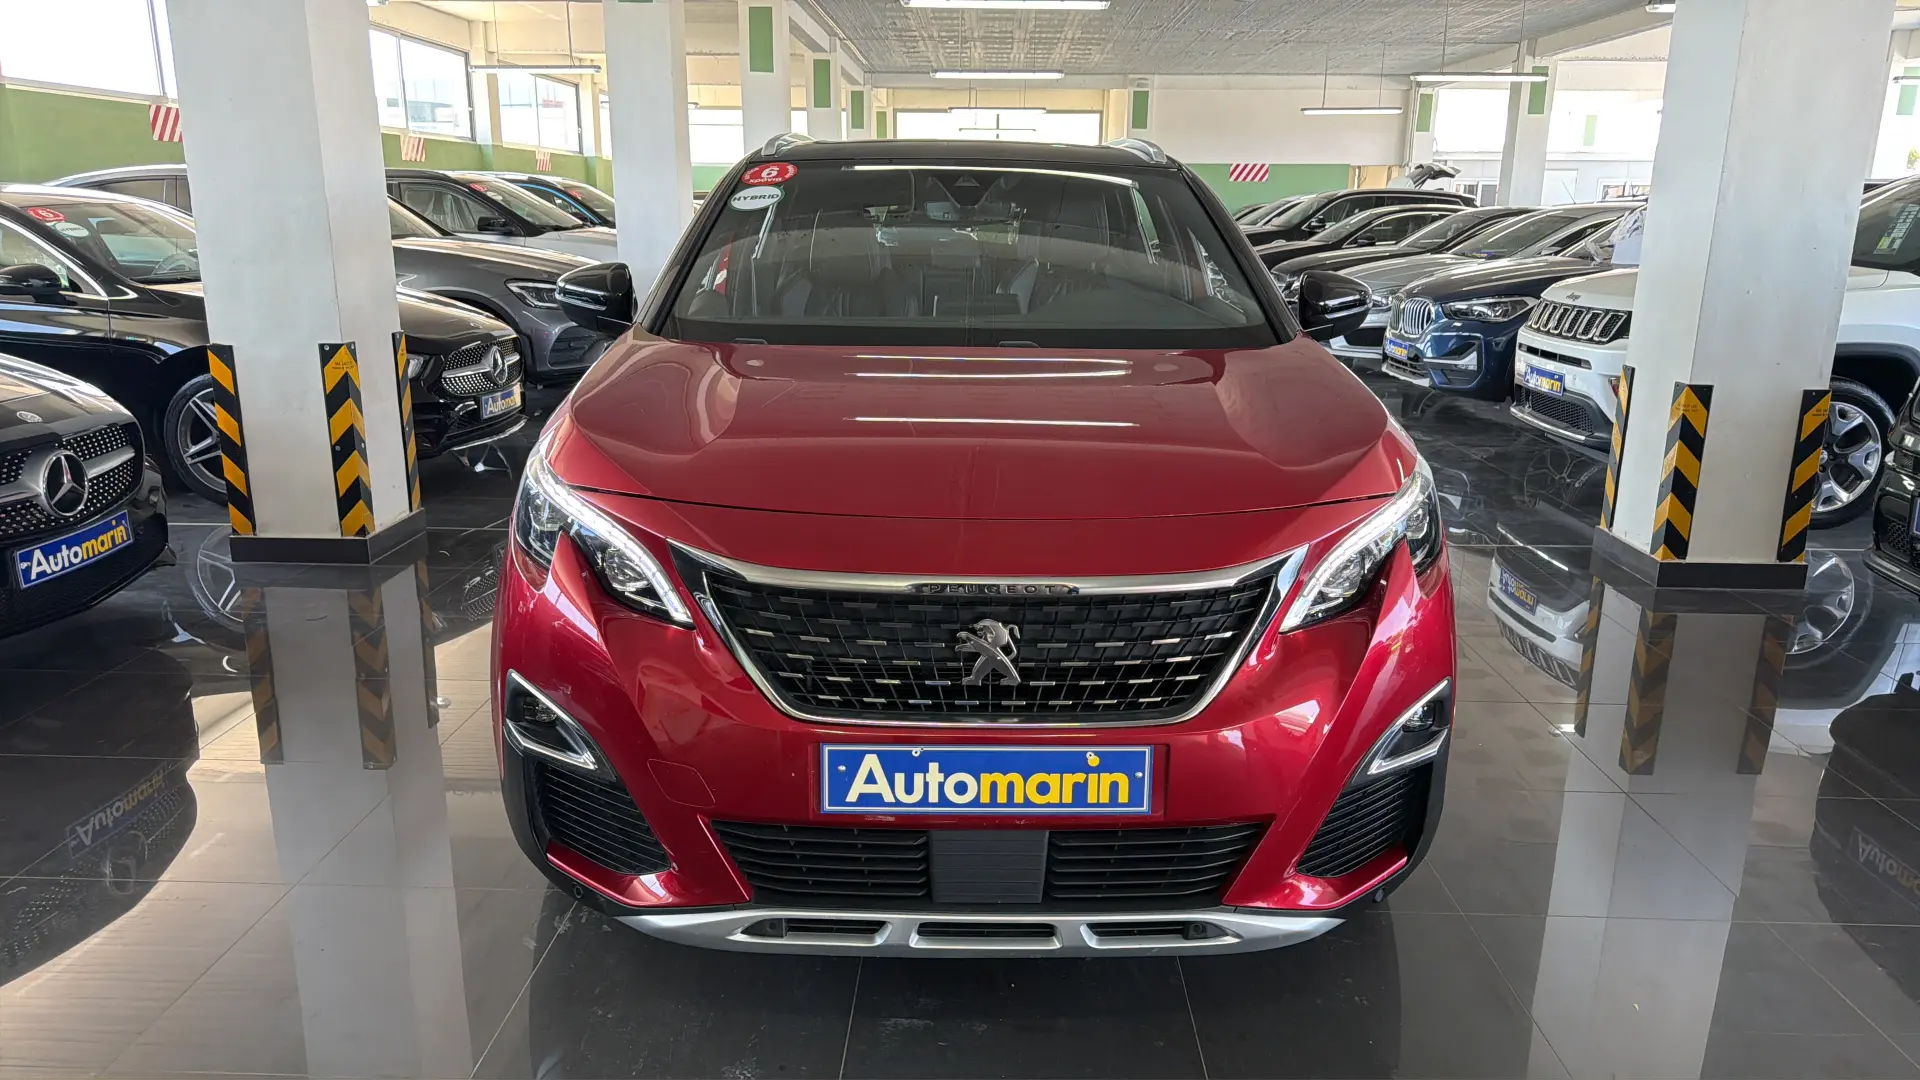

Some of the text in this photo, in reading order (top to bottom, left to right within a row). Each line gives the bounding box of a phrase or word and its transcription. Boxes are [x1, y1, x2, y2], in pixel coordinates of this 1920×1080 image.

[761, 167, 779, 178] 6
[733, 193, 780, 202] HYBRID
[30, 519, 128, 580] Automarin
[929, 584, 1056, 594] PEUGEOT
[845, 752, 1129, 804] Automarin
